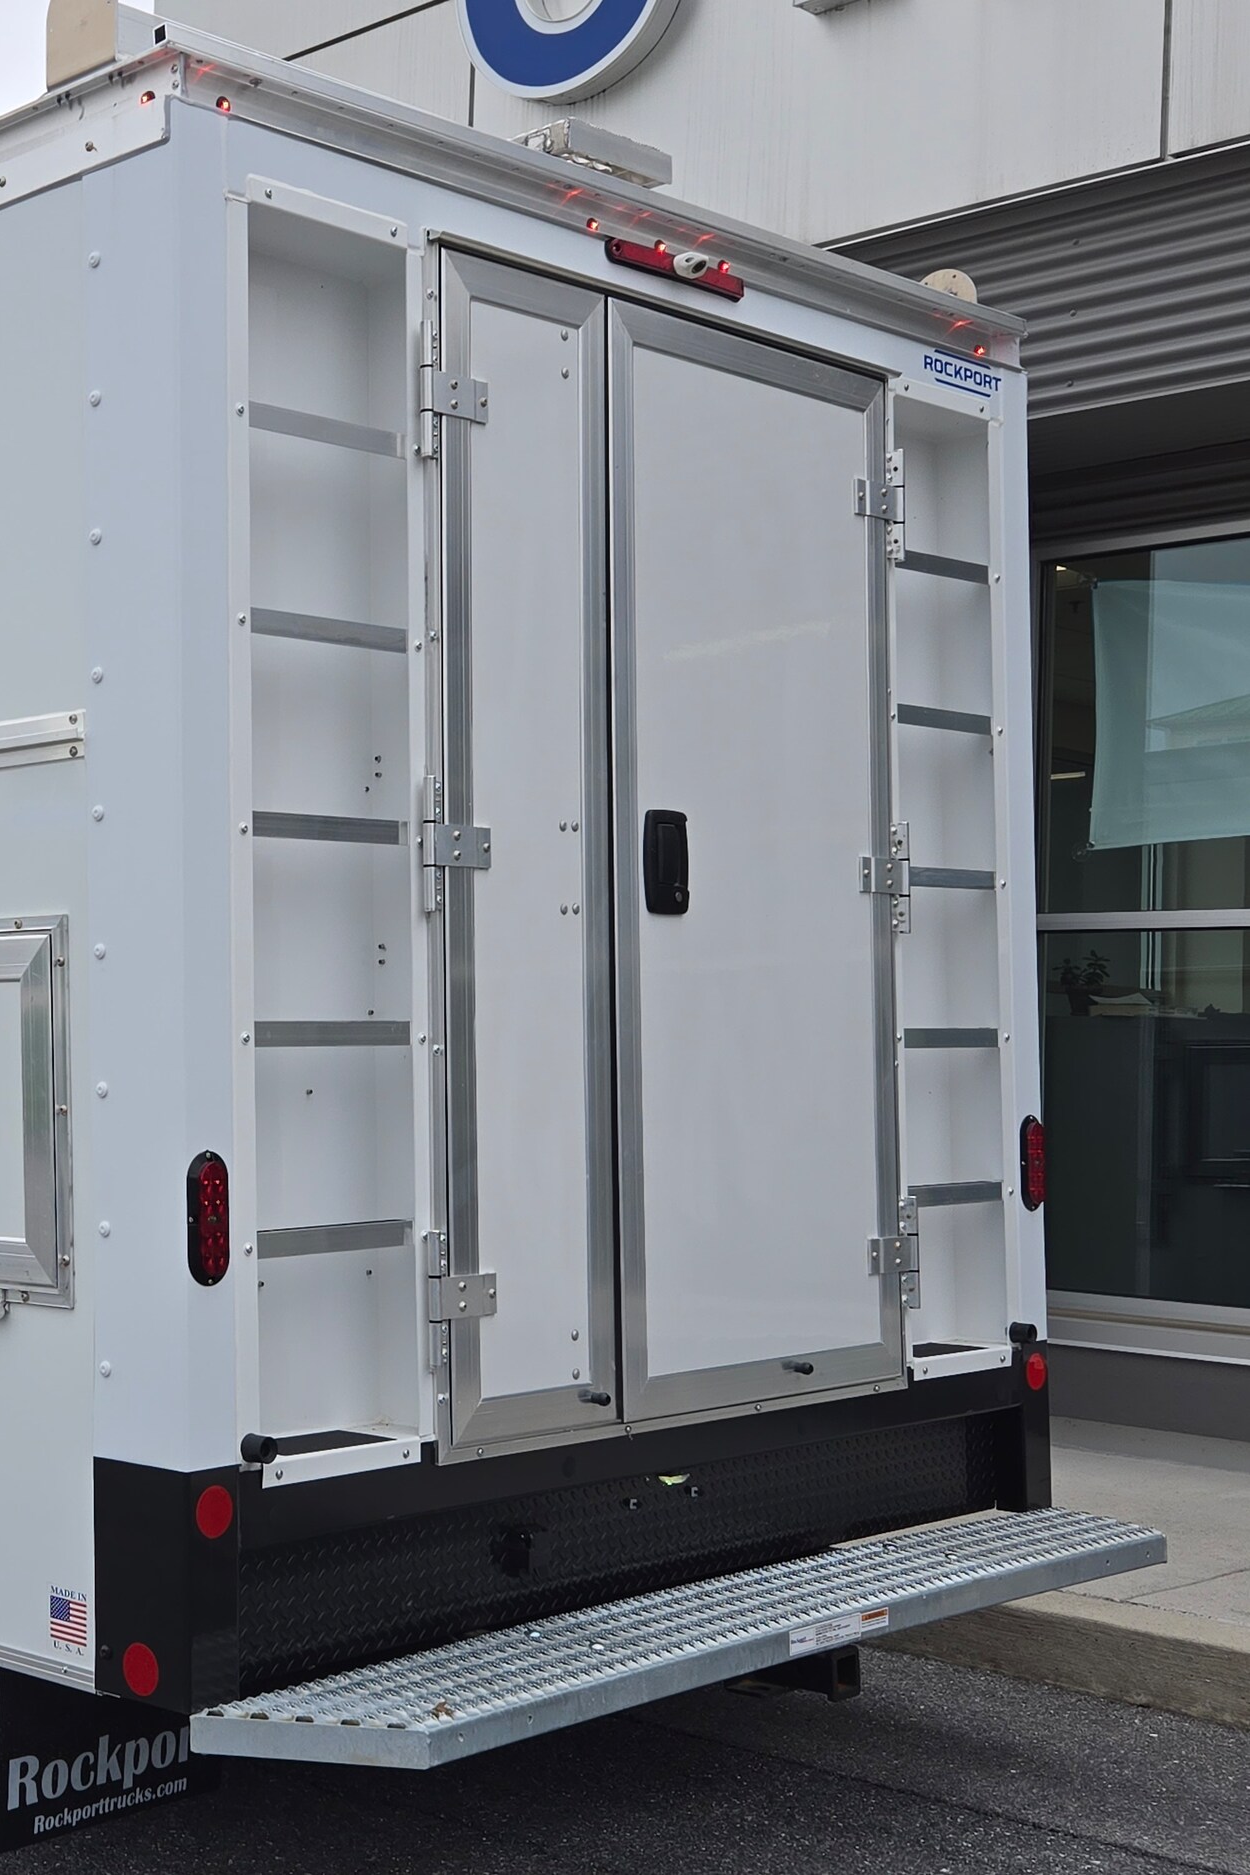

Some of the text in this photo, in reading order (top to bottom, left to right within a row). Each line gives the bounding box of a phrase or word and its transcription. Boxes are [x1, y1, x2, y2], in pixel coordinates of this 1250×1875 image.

[923, 354, 1002, 392] ROCKPORT
[50, 1585, 87, 1602] MADE IN
[7, 1726, 190, 1811] Rockpor
[33, 1777, 188, 1835] Rockporttrucks.com
